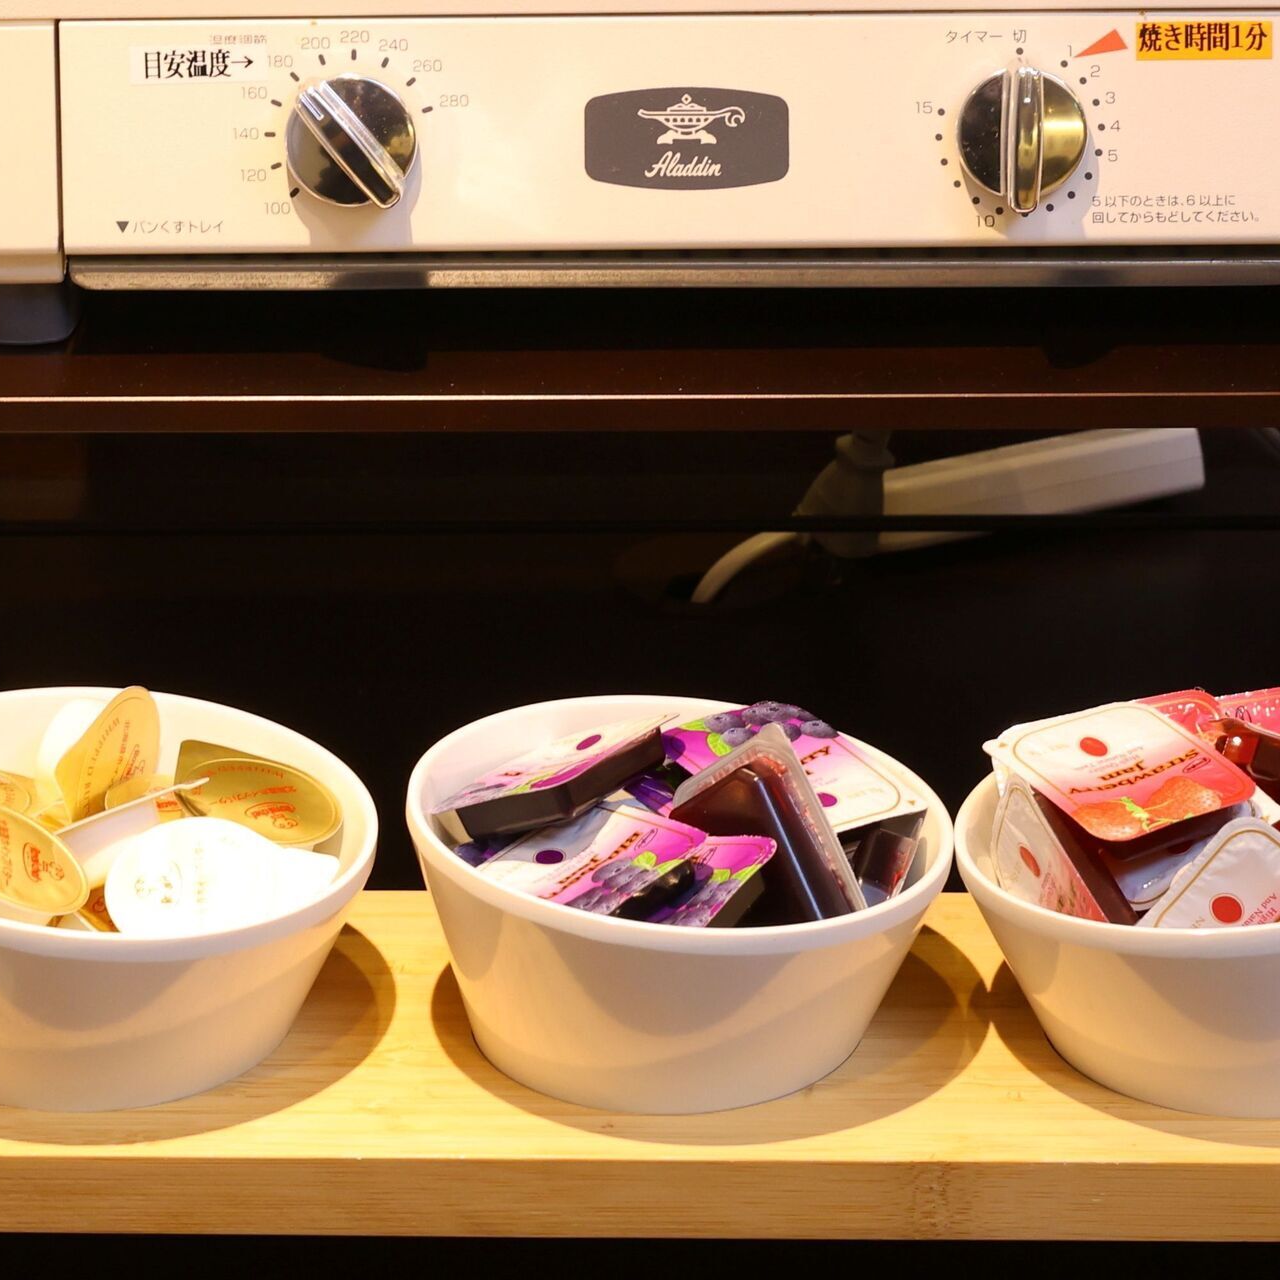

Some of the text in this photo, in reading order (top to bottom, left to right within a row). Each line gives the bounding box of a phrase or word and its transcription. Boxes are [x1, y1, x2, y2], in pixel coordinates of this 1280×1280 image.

[300, 36, 331, 50] 200
[339, 30, 370, 44] 220
[945, 28, 1027, 45] タイマー 切
[1137, 23, 1269, 54] 焼き時間1分
[378, 38, 409, 52] 240
[1067, 45, 1074, 57] 1
[143, 48, 231, 79] 目安温度
[266, 54, 294, 68] 180
[412, 59, 443, 72] 260
[1090, 65, 1100, 78] 2
[240, 86, 267, 100] 160
[1105, 92, 1115, 105] 3
[439, 94, 470, 108] 280
[915, 101, 933, 114] 15
[1110, 120, 1121, 132] 4
[232, 127, 260, 141] 140
[1108, 150, 1118, 162] 5
[644, 151, 722, 178] Aladdin
[240, 168, 267, 182] 120
[264, 201, 291, 215] 100
[975, 215, 995, 228] 10
[1092, 210, 1259, 224] 回してからもどしてください。
[1069, 748, 1200, 795] Strawberry
[1100, 760, 1147, 781] Jam
